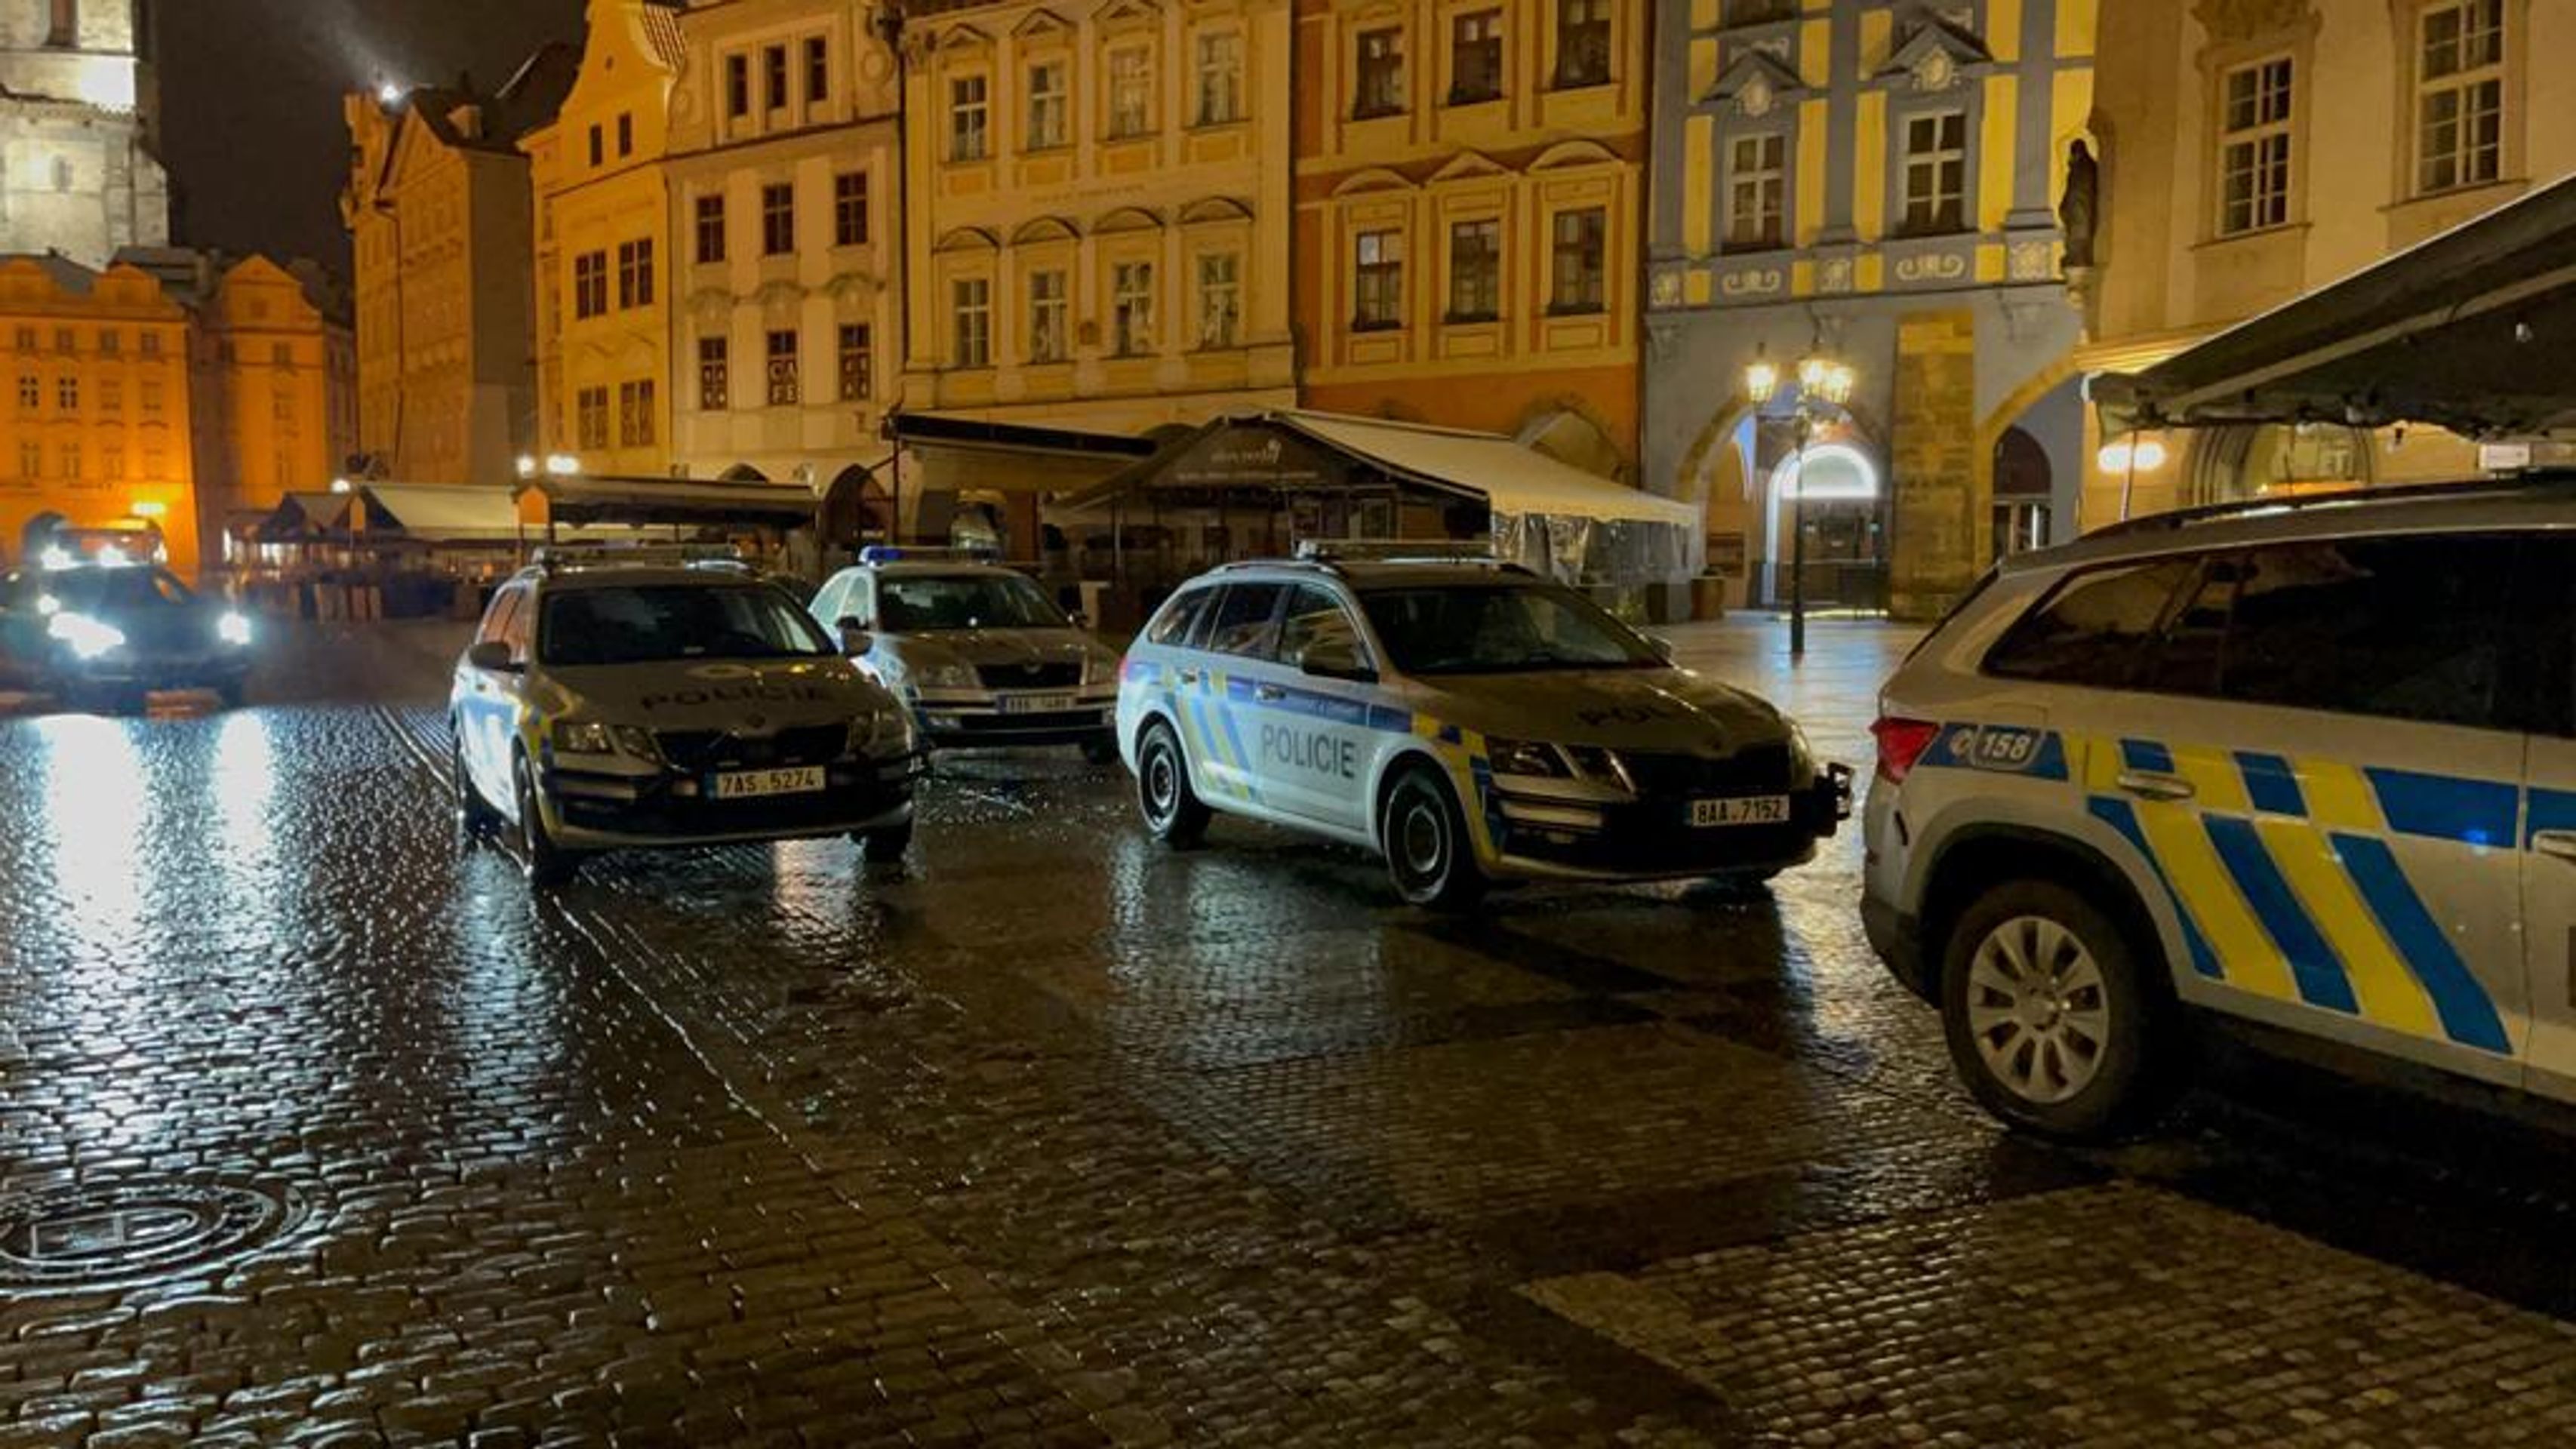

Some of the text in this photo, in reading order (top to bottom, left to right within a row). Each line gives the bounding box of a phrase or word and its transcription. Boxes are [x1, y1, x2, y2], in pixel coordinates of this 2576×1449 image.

[1261, 724, 1356, 779] POLICIE
[1980, 733, 2032, 761] 158
[722, 770, 814, 793] 7AS 5274
[1698, 801, 1728, 823] 8AA
